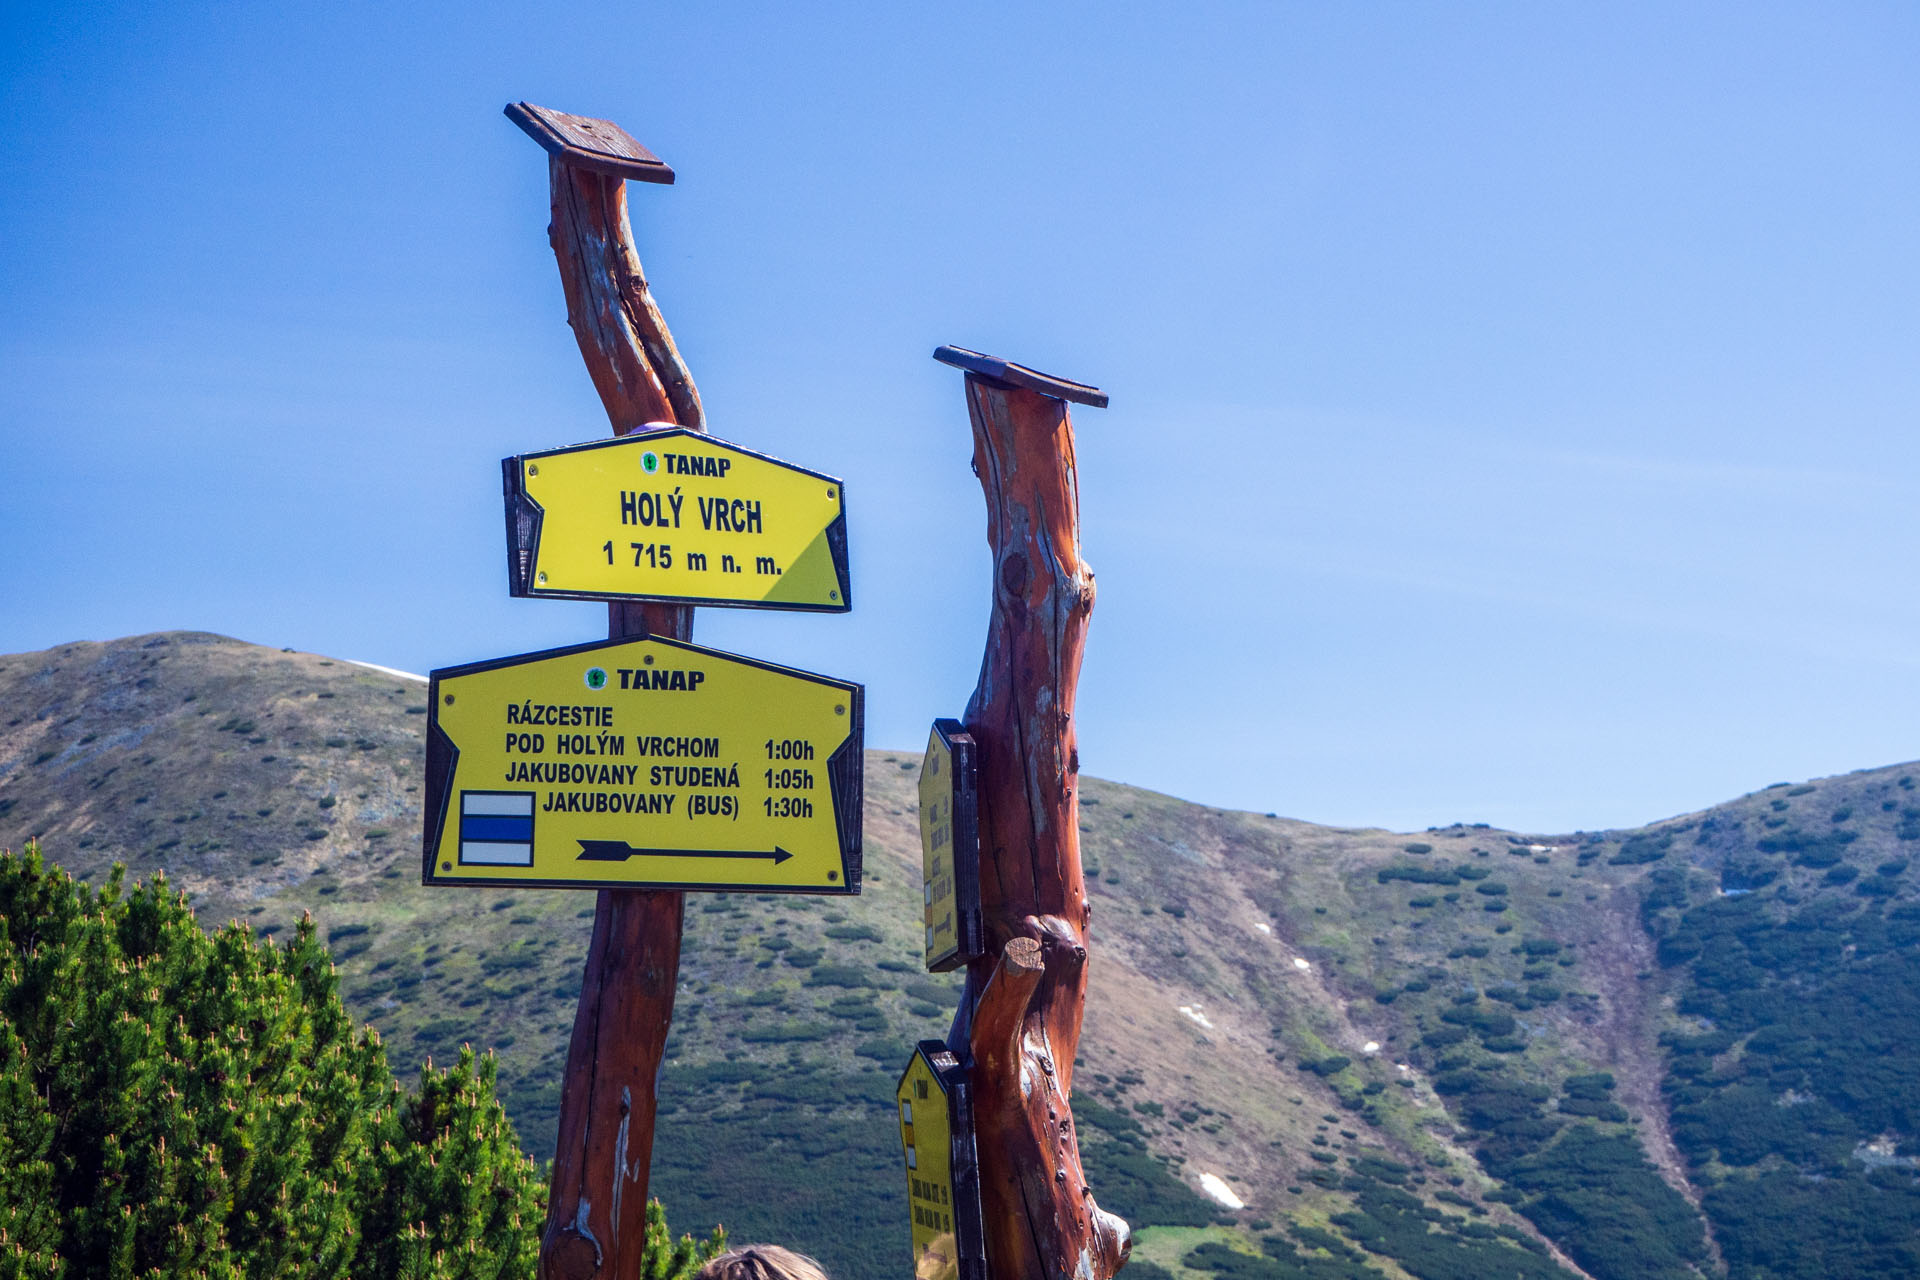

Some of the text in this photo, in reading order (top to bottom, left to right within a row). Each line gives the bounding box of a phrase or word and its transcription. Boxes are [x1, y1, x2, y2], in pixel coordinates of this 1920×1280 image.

[663, 453, 731, 478] TANAP
[620, 486, 762, 534] HOLÝ VRCH
[603, 540, 782, 576] 1 715 m n. m.
[616, 668, 705, 692] TANAP
[507, 699, 613, 727] RÁZCESTIE
[505, 729, 814, 761] POD HOLÝM VRCHOM 1:00h
[504, 761, 814, 790] JAKUBOVANY STUDENÁ 1:05h
[542, 791, 813, 821] JAKUBOVANY (BUS) 1:30h
